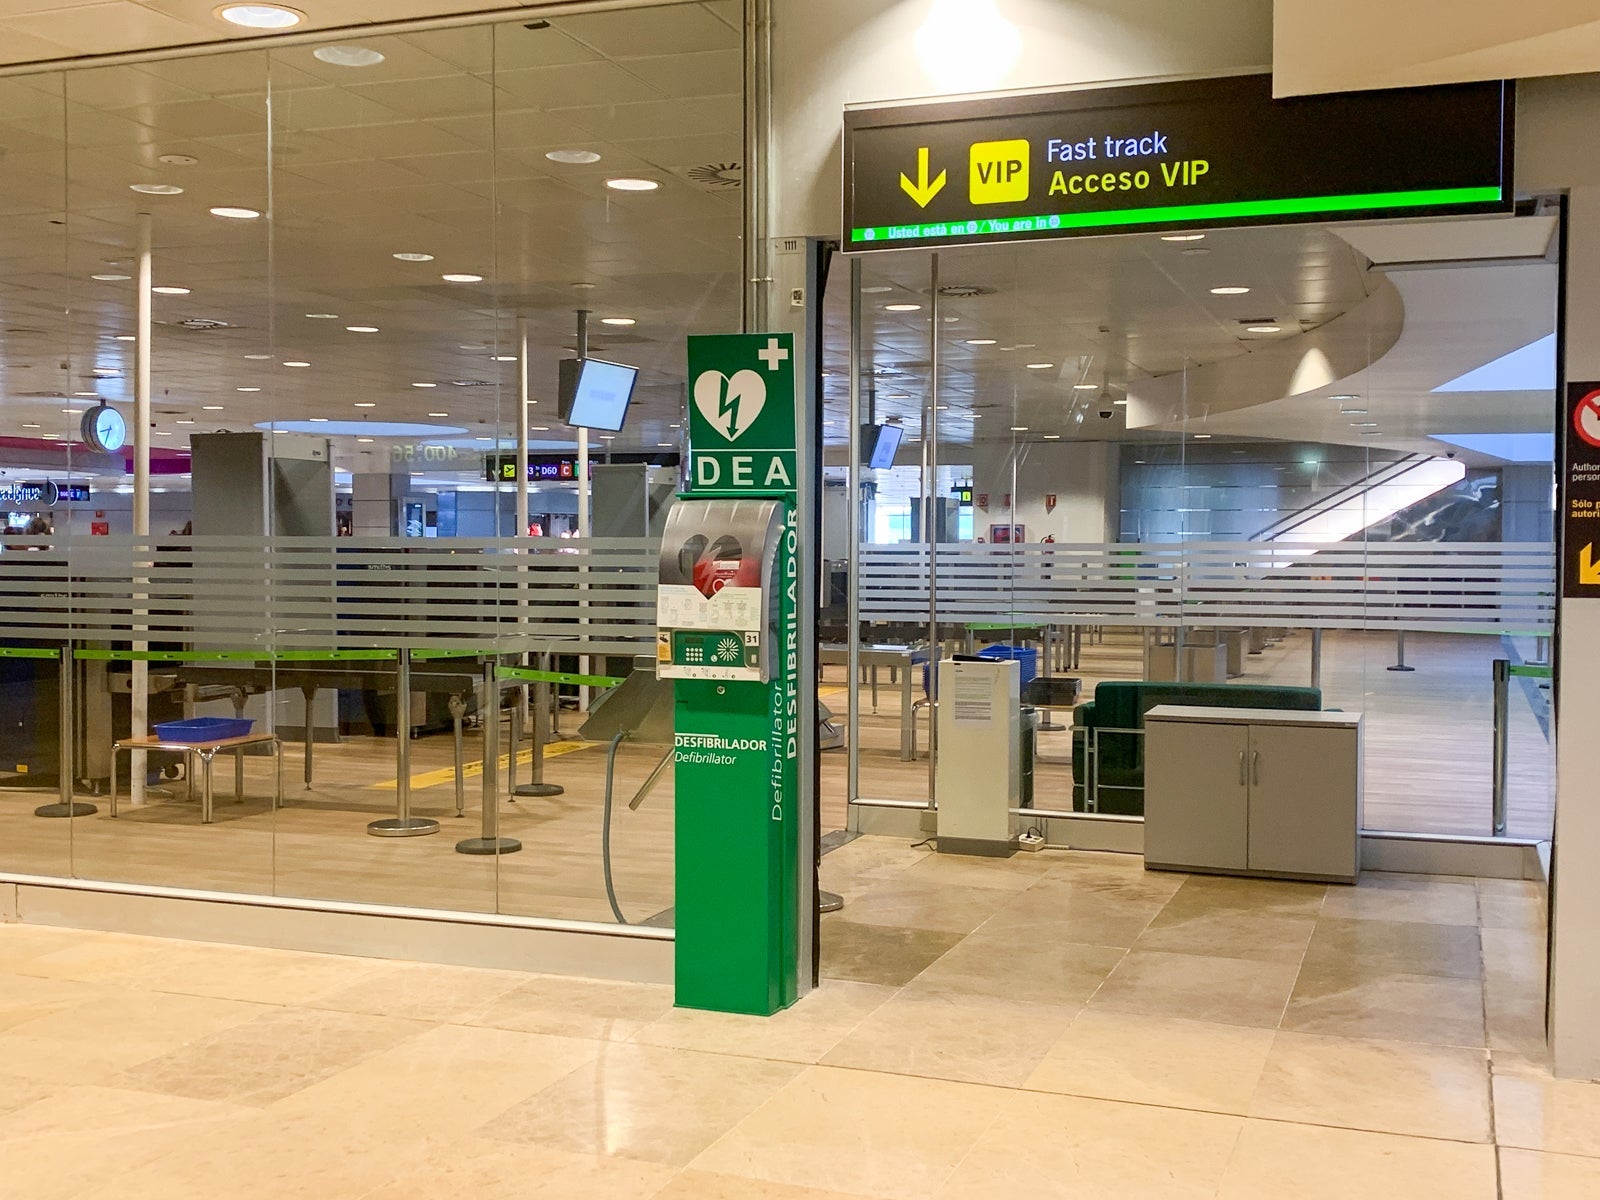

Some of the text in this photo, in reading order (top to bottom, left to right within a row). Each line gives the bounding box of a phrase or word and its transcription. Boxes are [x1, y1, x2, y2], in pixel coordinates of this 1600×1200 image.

[1048, 131, 1168, 163] Fast track
[977, 159, 1023, 185] VIP
[1049, 160, 1210, 196] Acceso VIP
[888, 225, 919, 238] Usted
[923, 223, 947, 237] está
[950, 225, 964, 235] en
[988, 219, 1009, 232] You
[1013, 219, 1032, 231] are
[1036, 216, 1047, 228] in
[541, 466, 558, 475] D60
[1572, 500, 1593, 508] Sólo
[746, 635, 758, 644] 31
[787, 509, 797, 759] DESFIBRILADOR
[675, 736, 767, 751] DESFIBRILADOR
[772, 682, 783, 821] Defibrillator
[675, 751, 737, 765] Defibrillator
